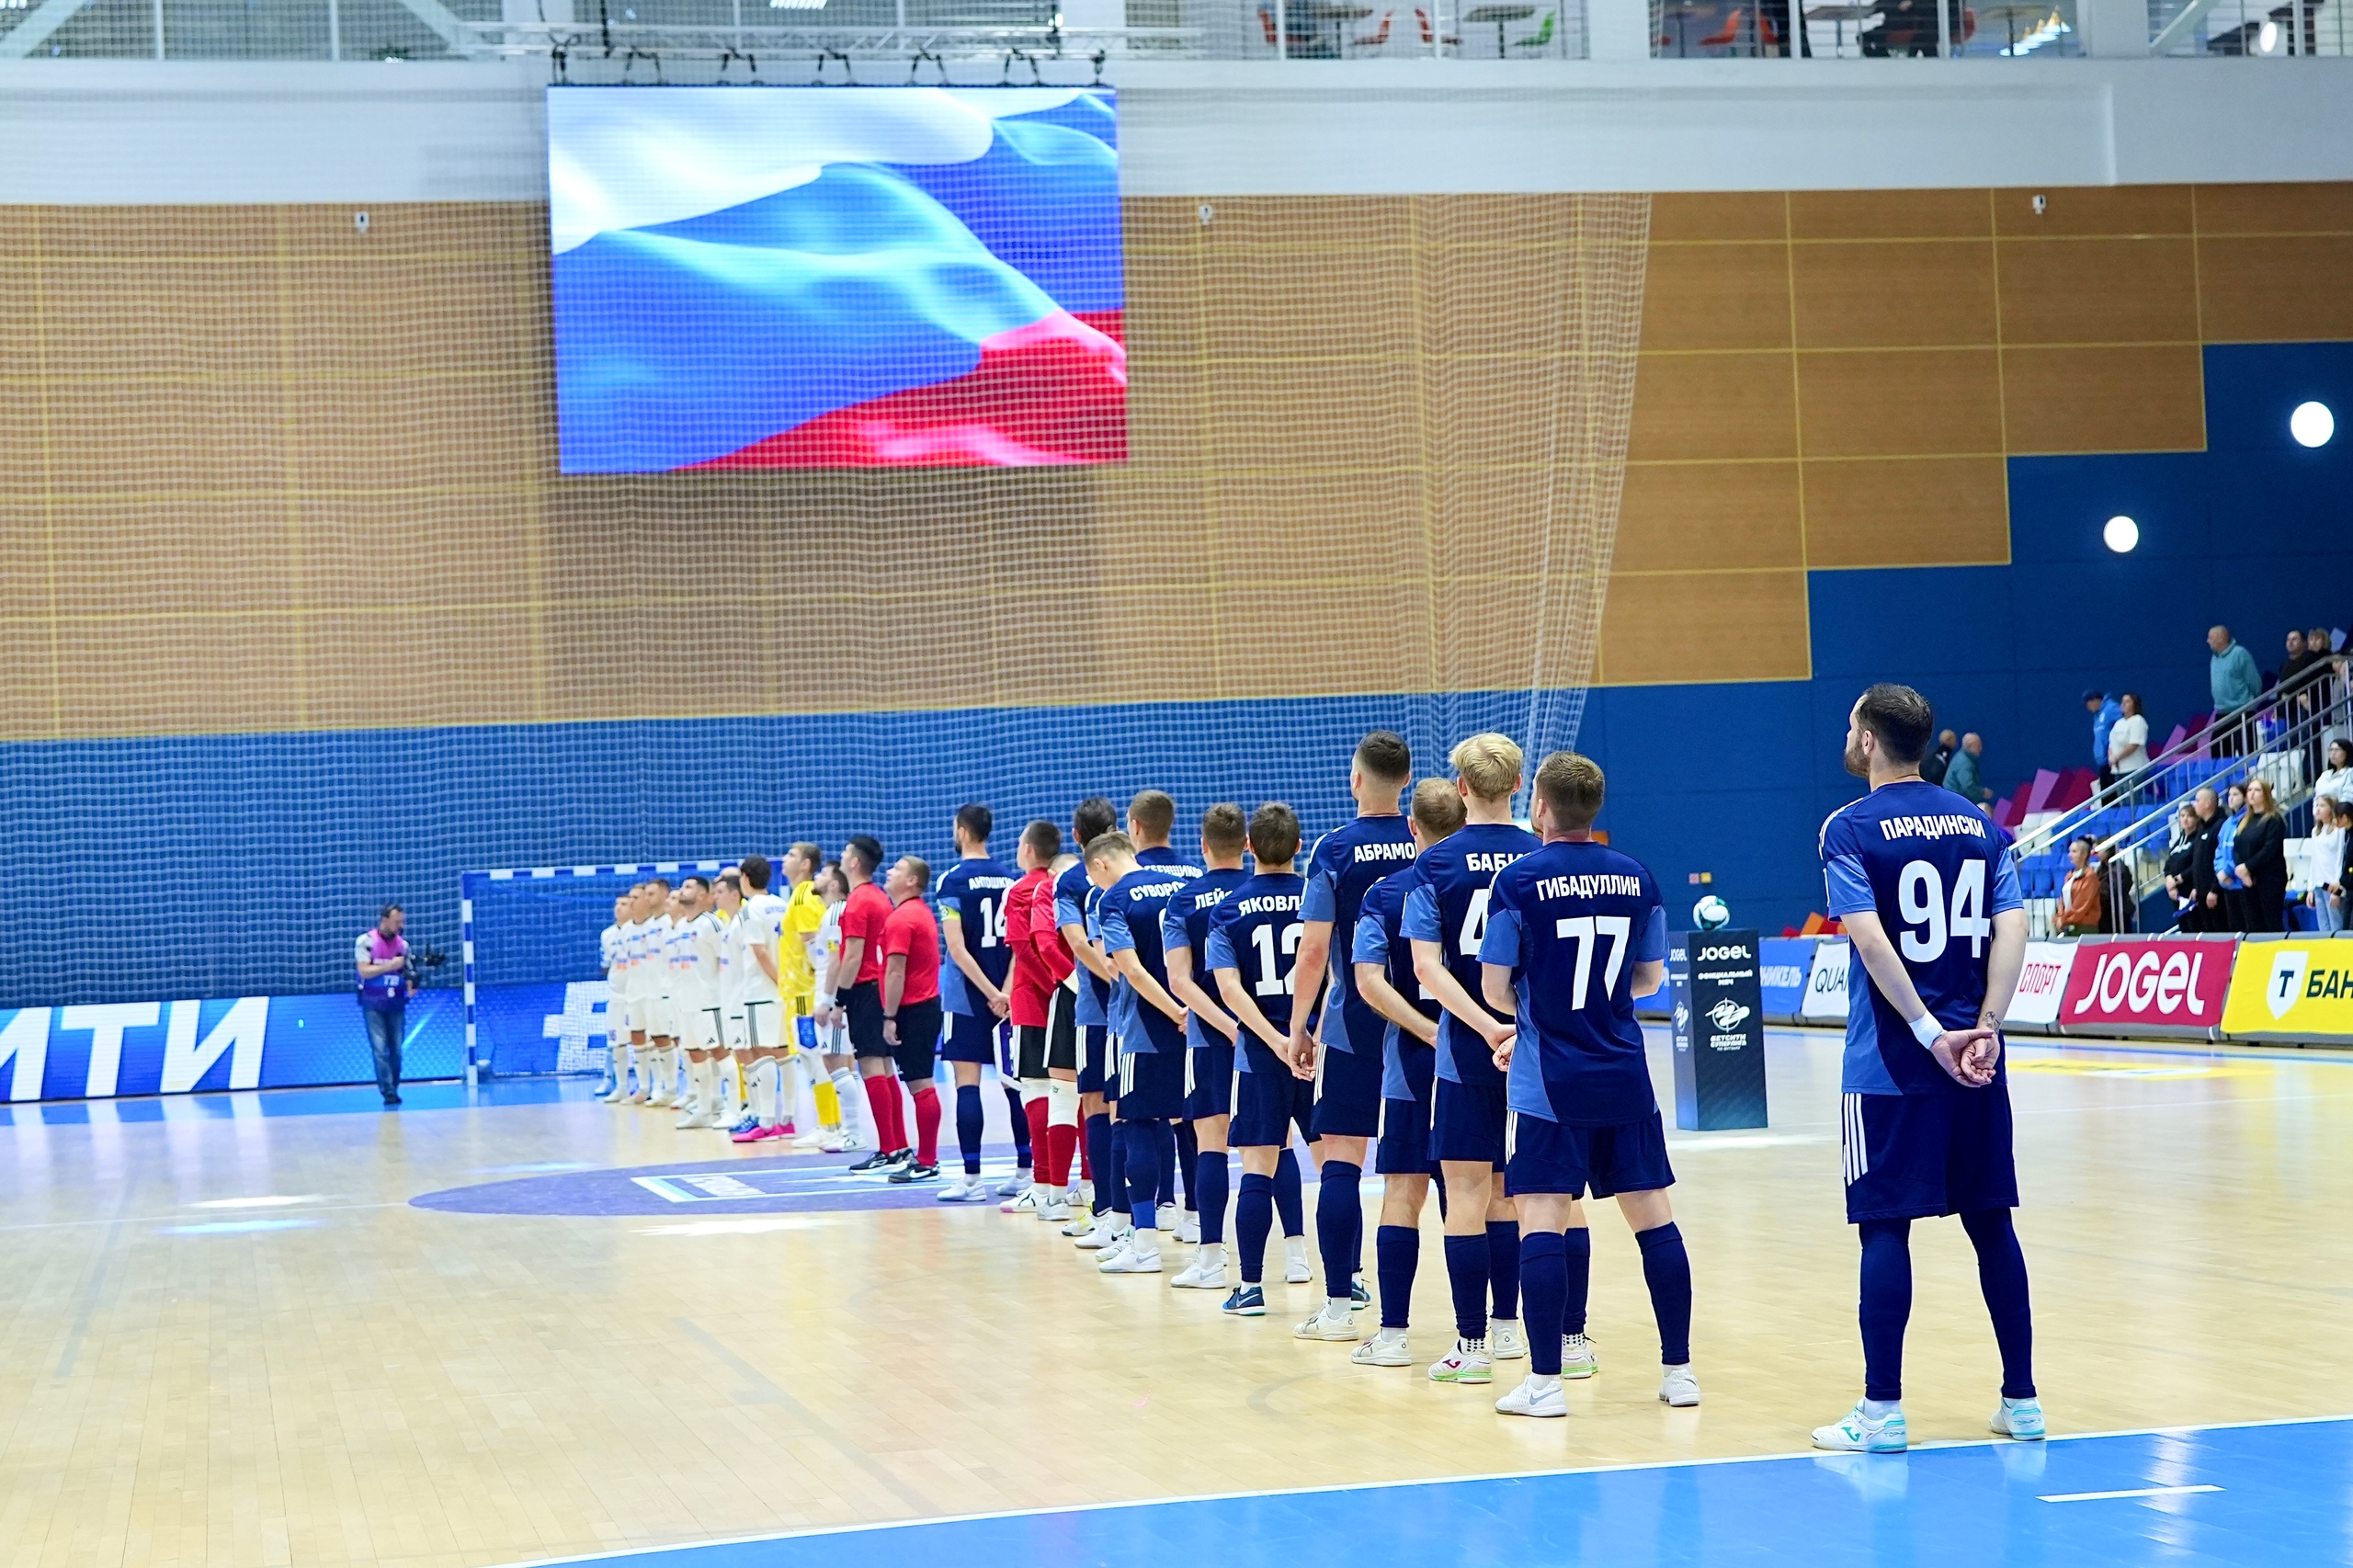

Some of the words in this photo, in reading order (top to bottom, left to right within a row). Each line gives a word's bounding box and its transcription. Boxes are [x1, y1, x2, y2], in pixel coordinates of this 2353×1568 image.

[1880, 815, 1986, 840] ПАРАДИНСКИ
[1354, 842, 1417, 863] АБРАМО
[1195, 888, 1233, 910] ЛЕЙ
[1536, 874, 1641, 901] ГИБАДУЛЛИН
[1898, 859, 1991, 963] 94
[1252, 923, 1305, 996] 12
[1556, 915, 1631, 1011] 77
[1815, 967, 1848, 994] QUA
[2018, 963, 2062, 994] СПОРТ
